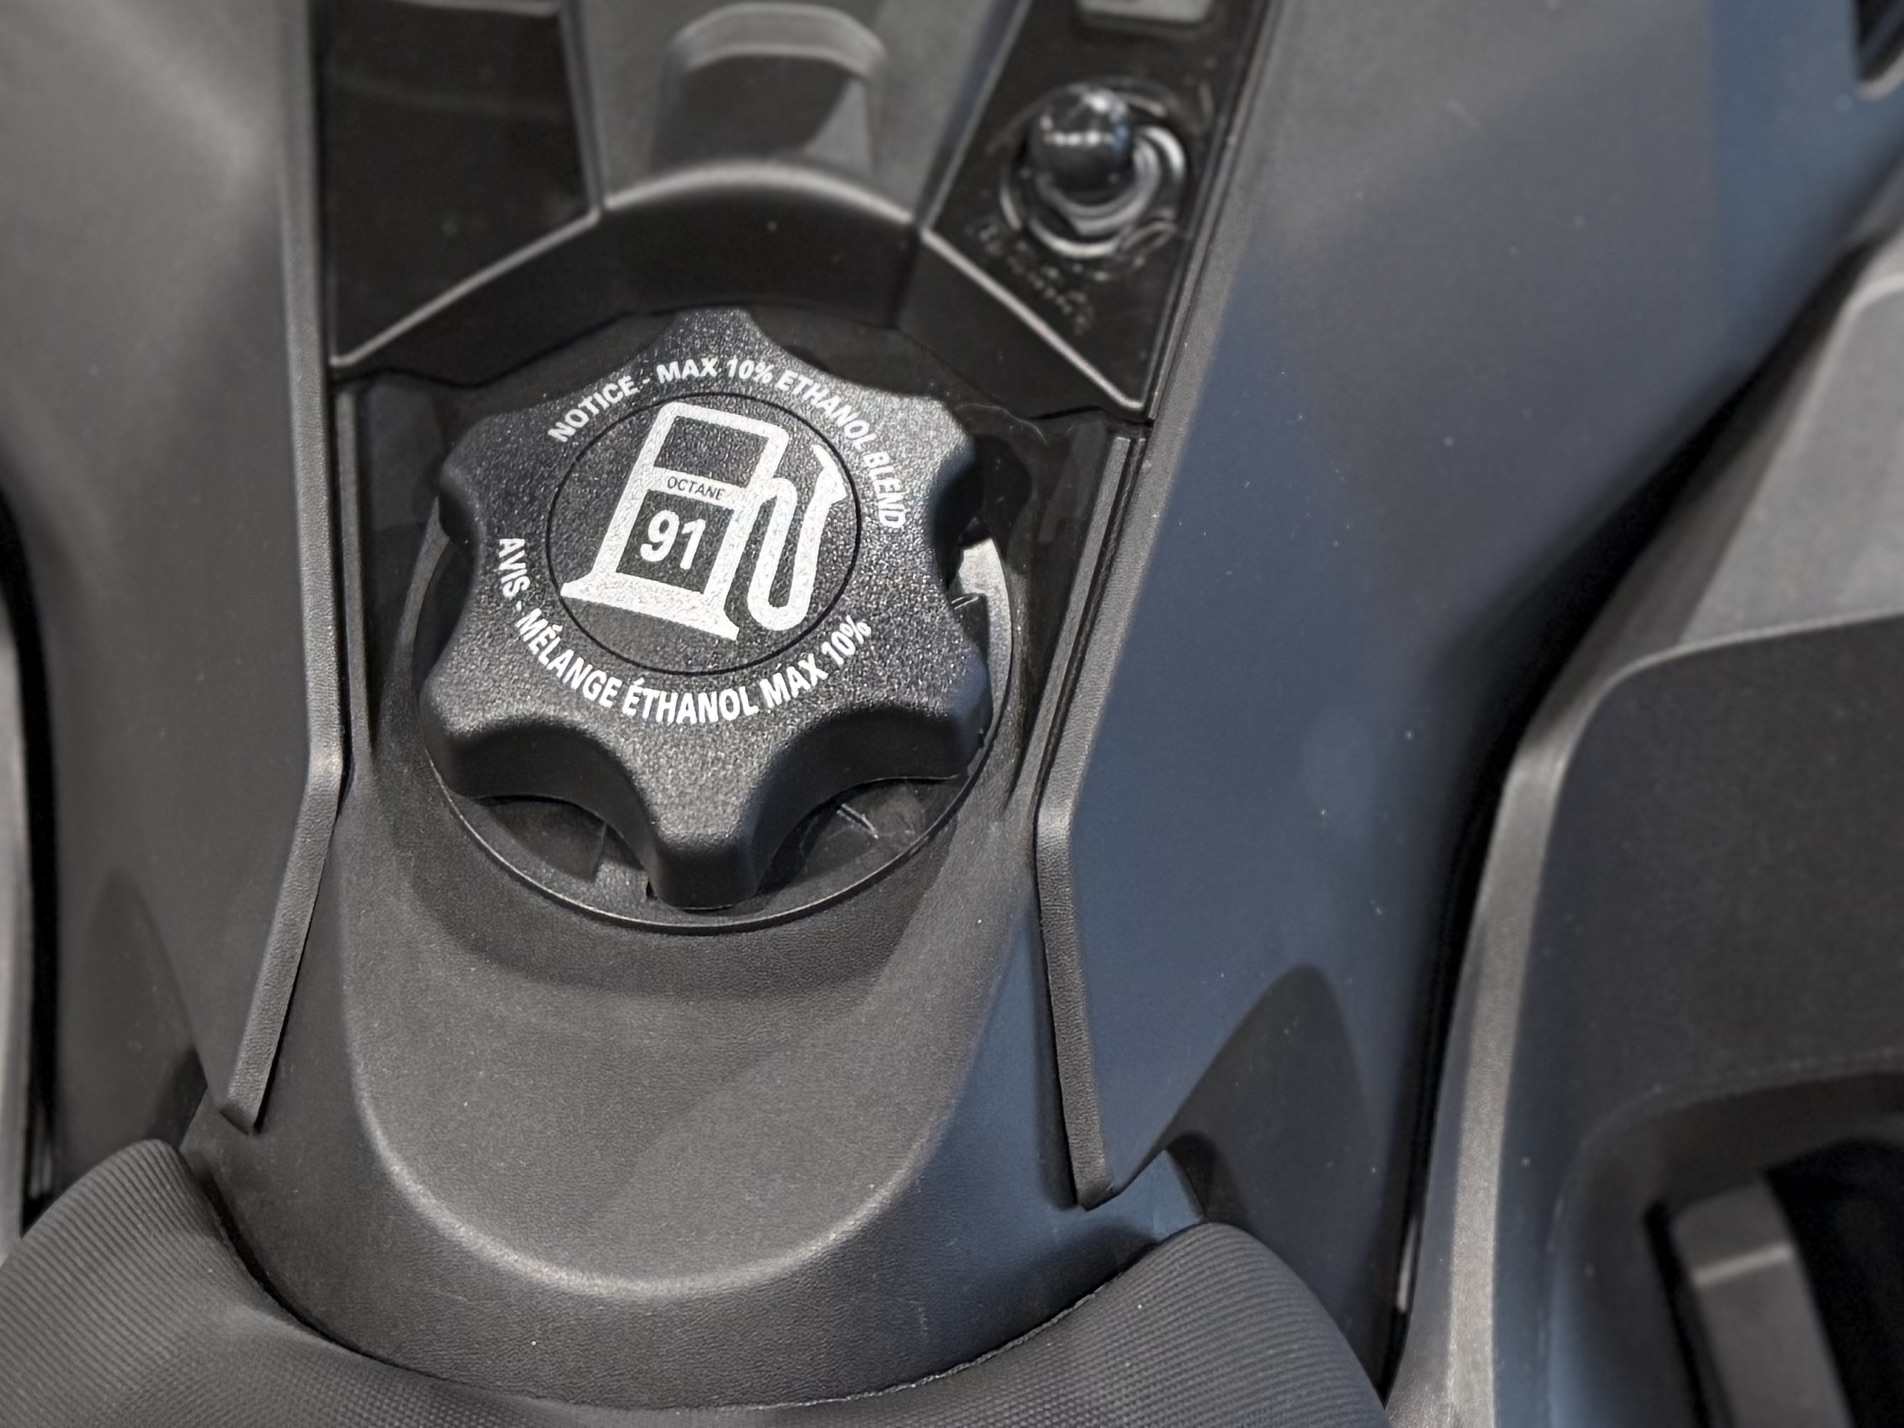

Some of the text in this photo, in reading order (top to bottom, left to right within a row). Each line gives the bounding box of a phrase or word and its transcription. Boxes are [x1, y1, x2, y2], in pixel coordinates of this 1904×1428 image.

[547, 375, 639, 443] NOTICE
[656, 357, 719, 384] MAX
[726, 355, 775, 385] 10%
[775, 369, 877, 449] ETHANOL
[863, 451, 908, 529] BLEND
[667, 476, 726, 501] OCTANE
[640, 509, 707, 570] 91
[498, 538, 531, 598] AVIS
[515, 608, 623, 708] MÉLANGE
[621, 677, 759, 725] ÉTHANOL
[759, 652, 829, 710] MAX
[820, 615, 872, 667] 10%
